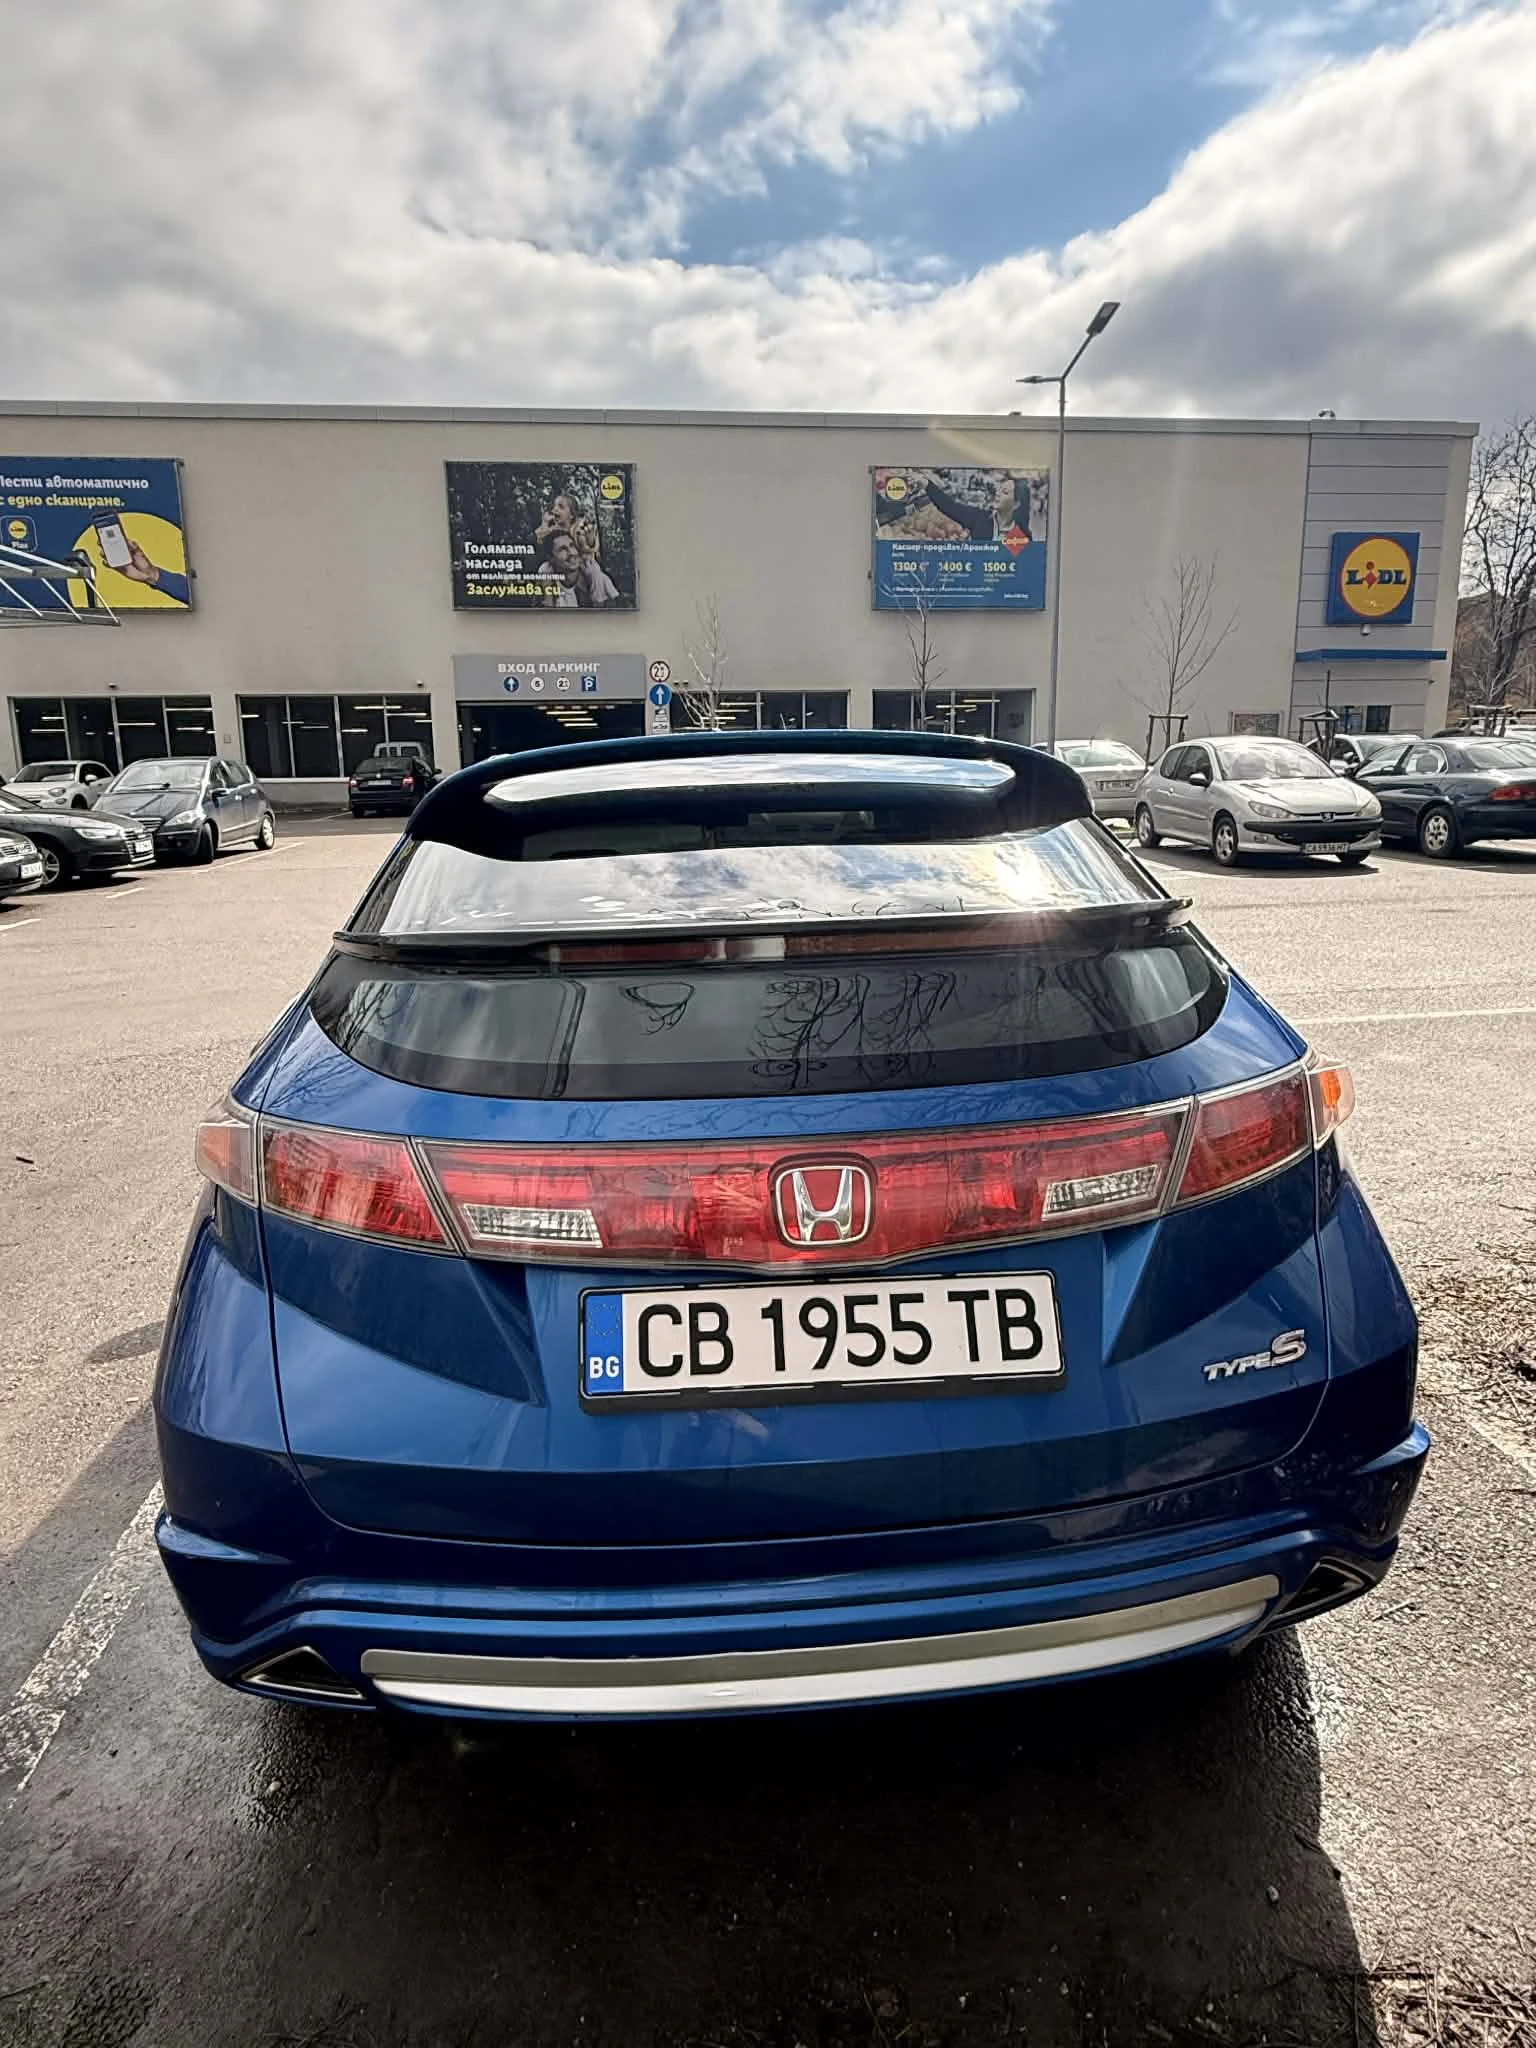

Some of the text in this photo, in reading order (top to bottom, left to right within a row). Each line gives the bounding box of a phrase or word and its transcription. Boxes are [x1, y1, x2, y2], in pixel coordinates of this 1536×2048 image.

[46, 475, 149, 489] автоматично
[8, 496, 42, 508] едно
[45, 494, 125, 509] сканиране.
[464, 541, 535, 554] Голямата
[465, 559, 523, 571] наслада
[984, 562, 1006, 572] 1500
[466, 583, 543, 597] Заслужава
[498, 663, 600, 674] ВХОД ПАРКИНГ
[638, 1288, 1044, 1378] CB 1955 TB
[589, 1356, 620, 1380] BG
